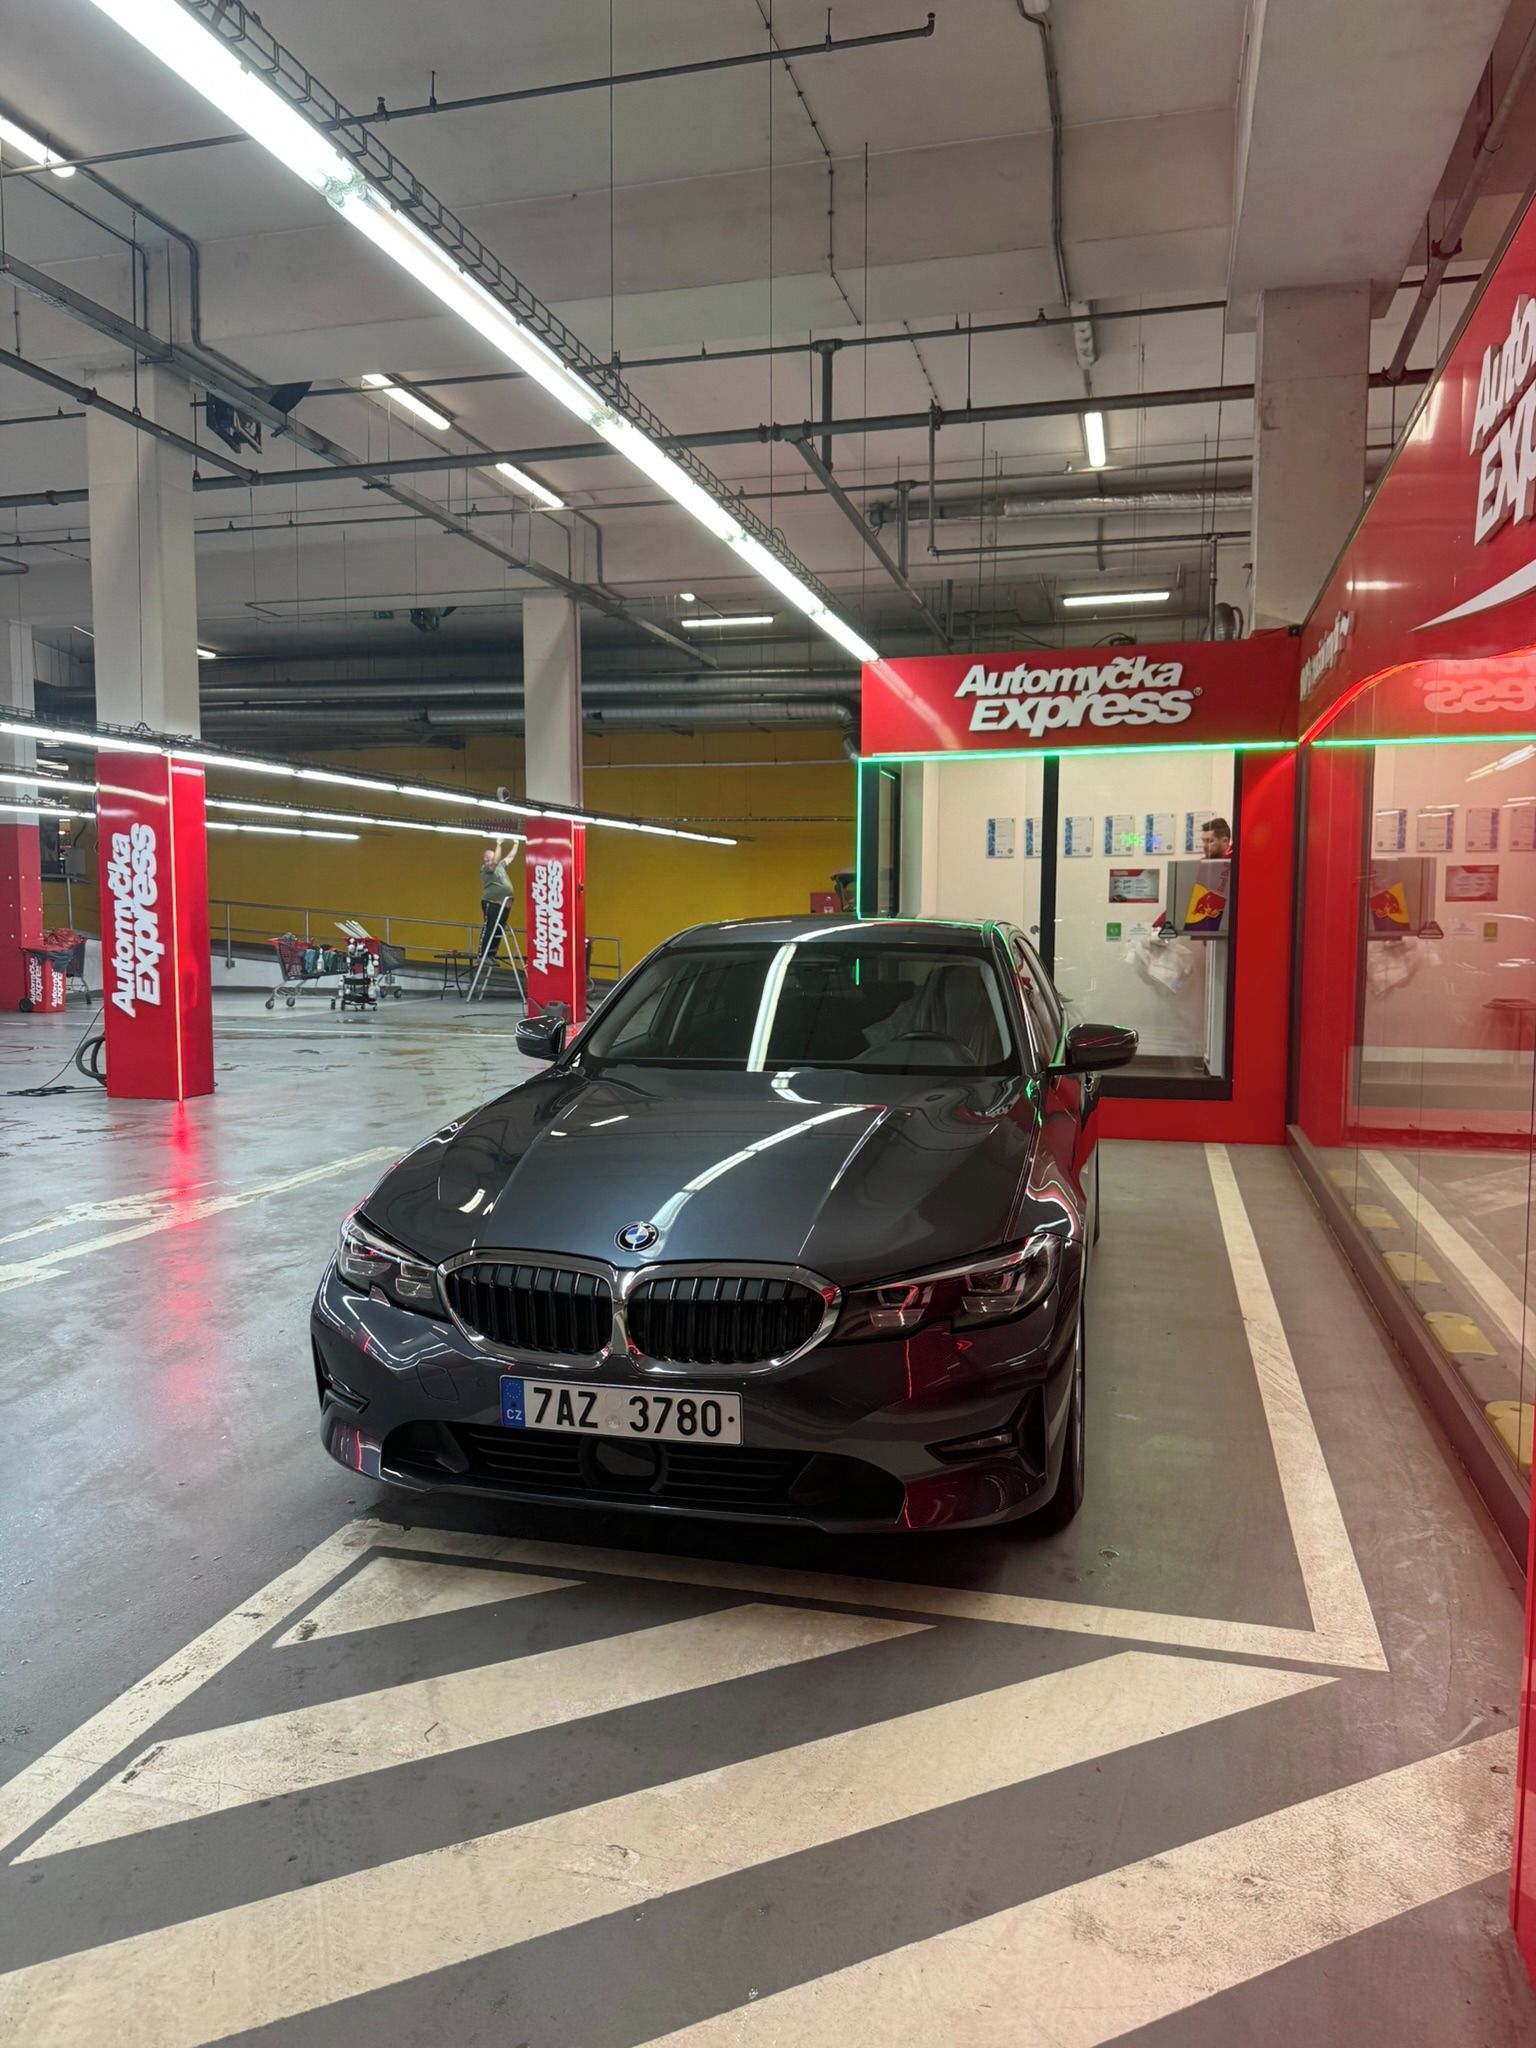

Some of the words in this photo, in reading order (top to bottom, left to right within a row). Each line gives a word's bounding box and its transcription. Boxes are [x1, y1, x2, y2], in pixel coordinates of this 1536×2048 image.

[1469, 293, 1536, 457] Auto
[954, 656, 1183, 697] Automyčka
[968, 690, 1194, 737] Express
[107, 832, 137, 1018] Automyčka
[130, 823, 165, 1006] Express
[532, 865, 548, 975] Automyčka
[547, 860, 567, 968] Express
[506, 1409, 523, 1420] CZ
[533, 1387, 598, 1428] 7AZ
[629, 1395, 722, 1437] 3780
